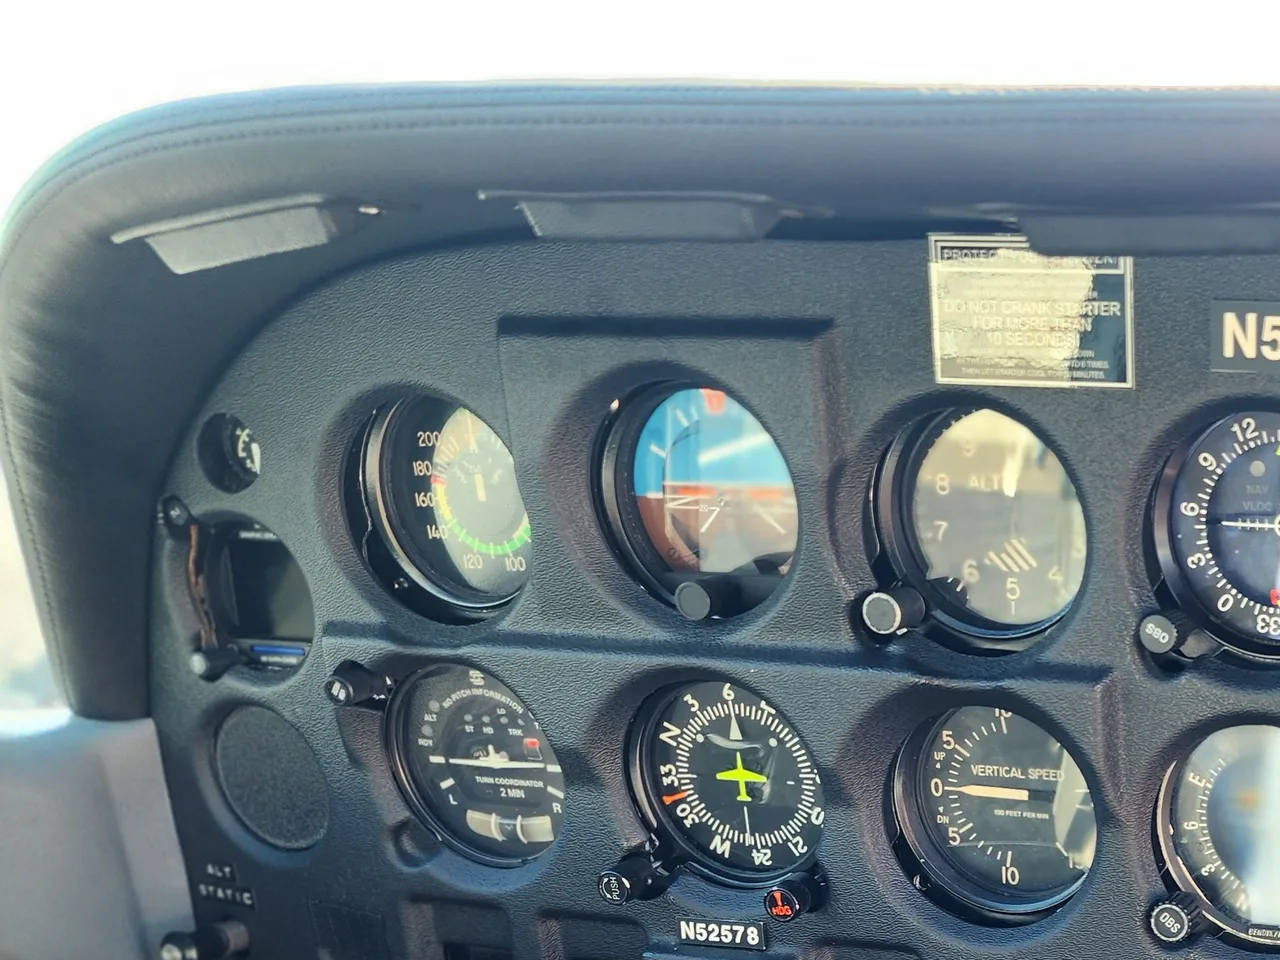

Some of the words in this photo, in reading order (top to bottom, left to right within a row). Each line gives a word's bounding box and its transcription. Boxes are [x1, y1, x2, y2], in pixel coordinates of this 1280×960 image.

[1001, 301, 1051, 314] CRANK
[1056, 301, 1121, 316] STARTER
[973, 316, 1001, 329] FOR
[1005, 317, 1049, 330] MORE
[1054, 317, 1092, 332] THAN
[1230, 417, 1260, 442] 12
[417, 431, 441, 446] 200
[413, 461, 432, 476] 180
[415, 492, 436, 507] 160
[427, 525, 448, 539] 140
[463, 555, 483, 569] 120
[505, 557, 526, 571] 100
[1144, 623, 1169, 644] OBS
[452, 689, 471, 702] PITCH
[471, 688, 524, 714] INFORMATION
[934, 752, 946, 761] UP
[660, 765, 679, 787] 33
[971, 764, 1025, 779] VERTICAL
[1028, 768, 1065, 782] SPEED
[475, 776, 494, 784] TURN
[495, 777, 544, 788] COORDINATOR
[676, 803, 699, 828] 30
[937, 815, 949, 824] DN
[752, 849, 773, 865] 24
[1001, 866, 1020, 885] 10
[199, 884, 252, 905] STATIC
[610, 876, 620, 900] PUSH
[772, 906, 792, 916] HDG
[1158, 911, 1181, 934] OBS
[680, 920, 760, 946] N52578
